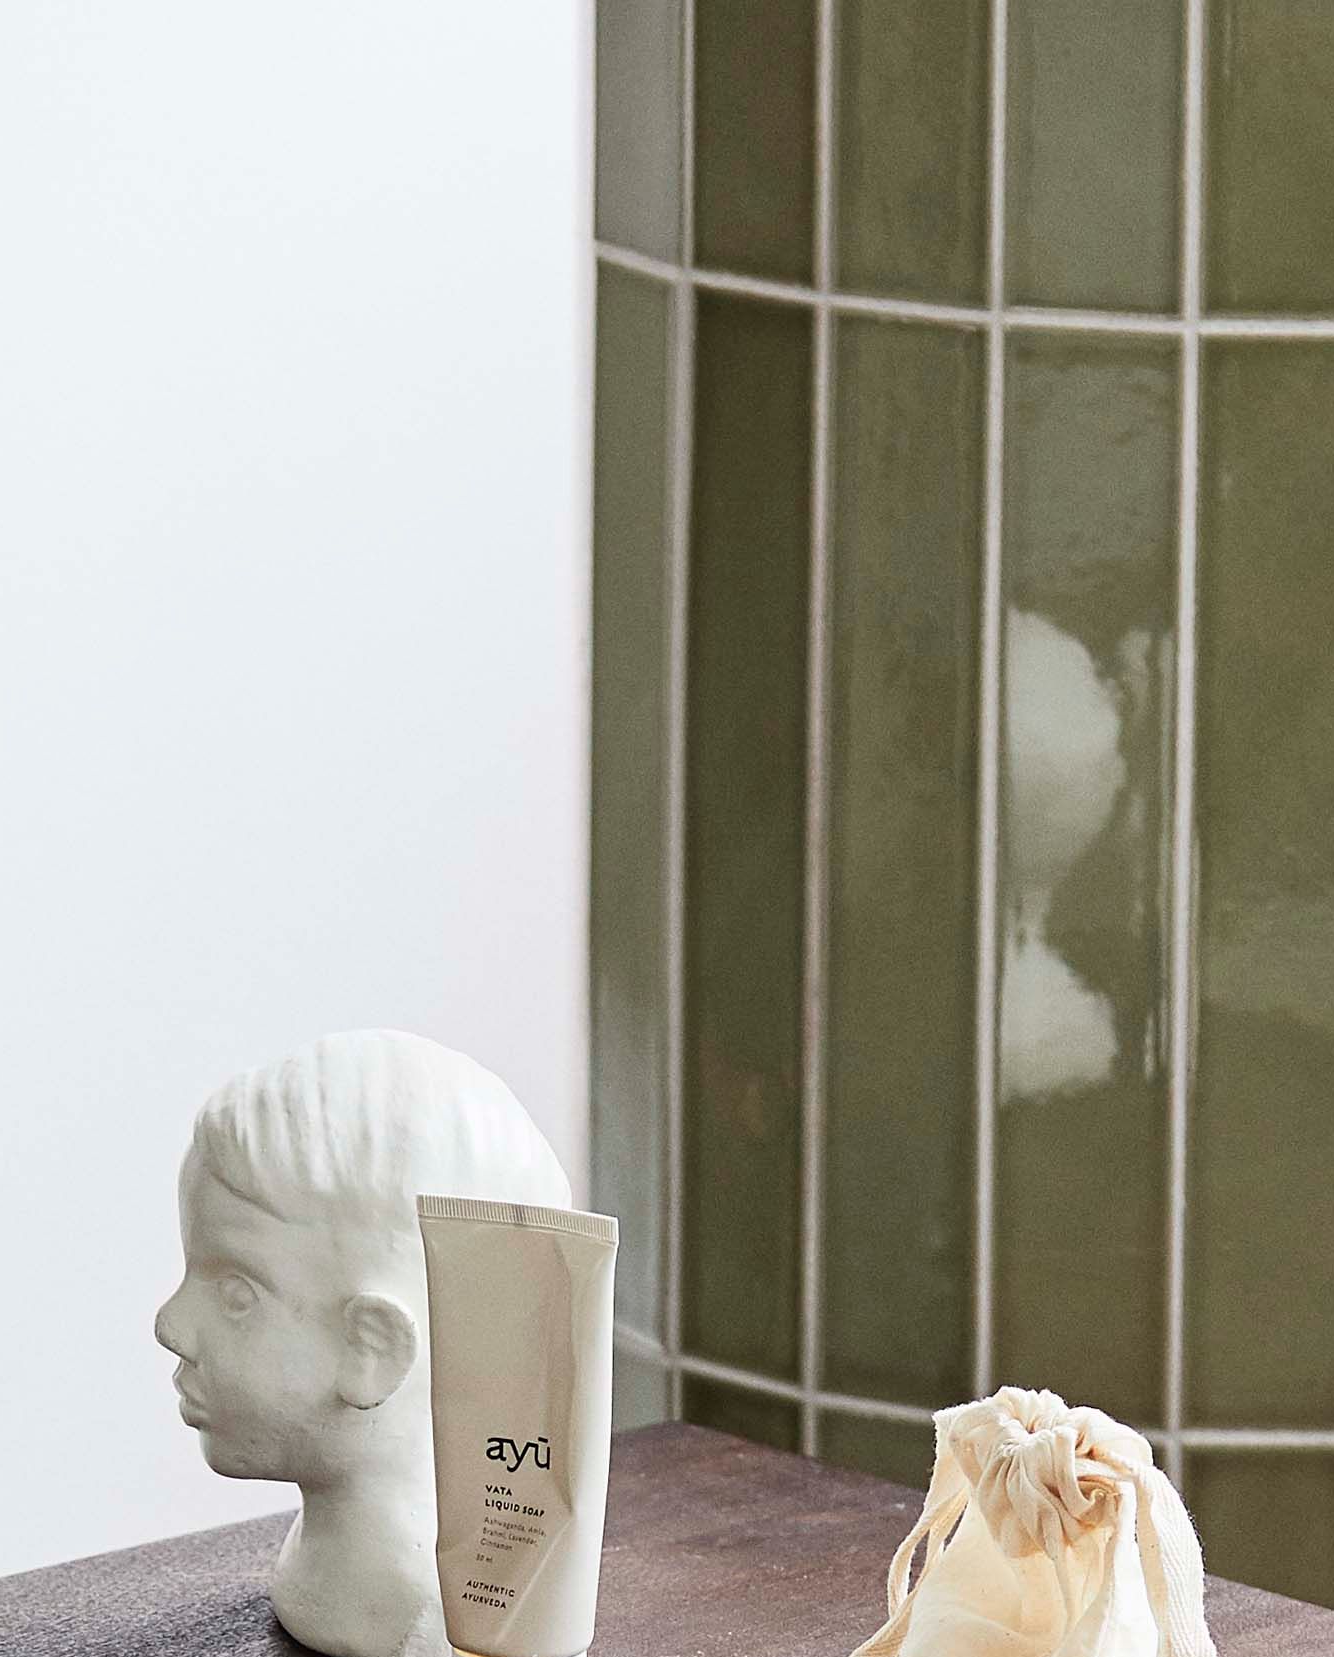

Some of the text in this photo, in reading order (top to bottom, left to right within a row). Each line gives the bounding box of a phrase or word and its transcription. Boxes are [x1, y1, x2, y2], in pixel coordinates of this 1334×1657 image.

[486, 1436, 551, 1472] ayū
[485, 1484, 513, 1497] VATA
[485, 1499, 545, 1518] LIQUID SOAP
[466, 1579, 516, 1598] AUTHENTIC
[462, 1592, 507, 1610] AYURVEDA
